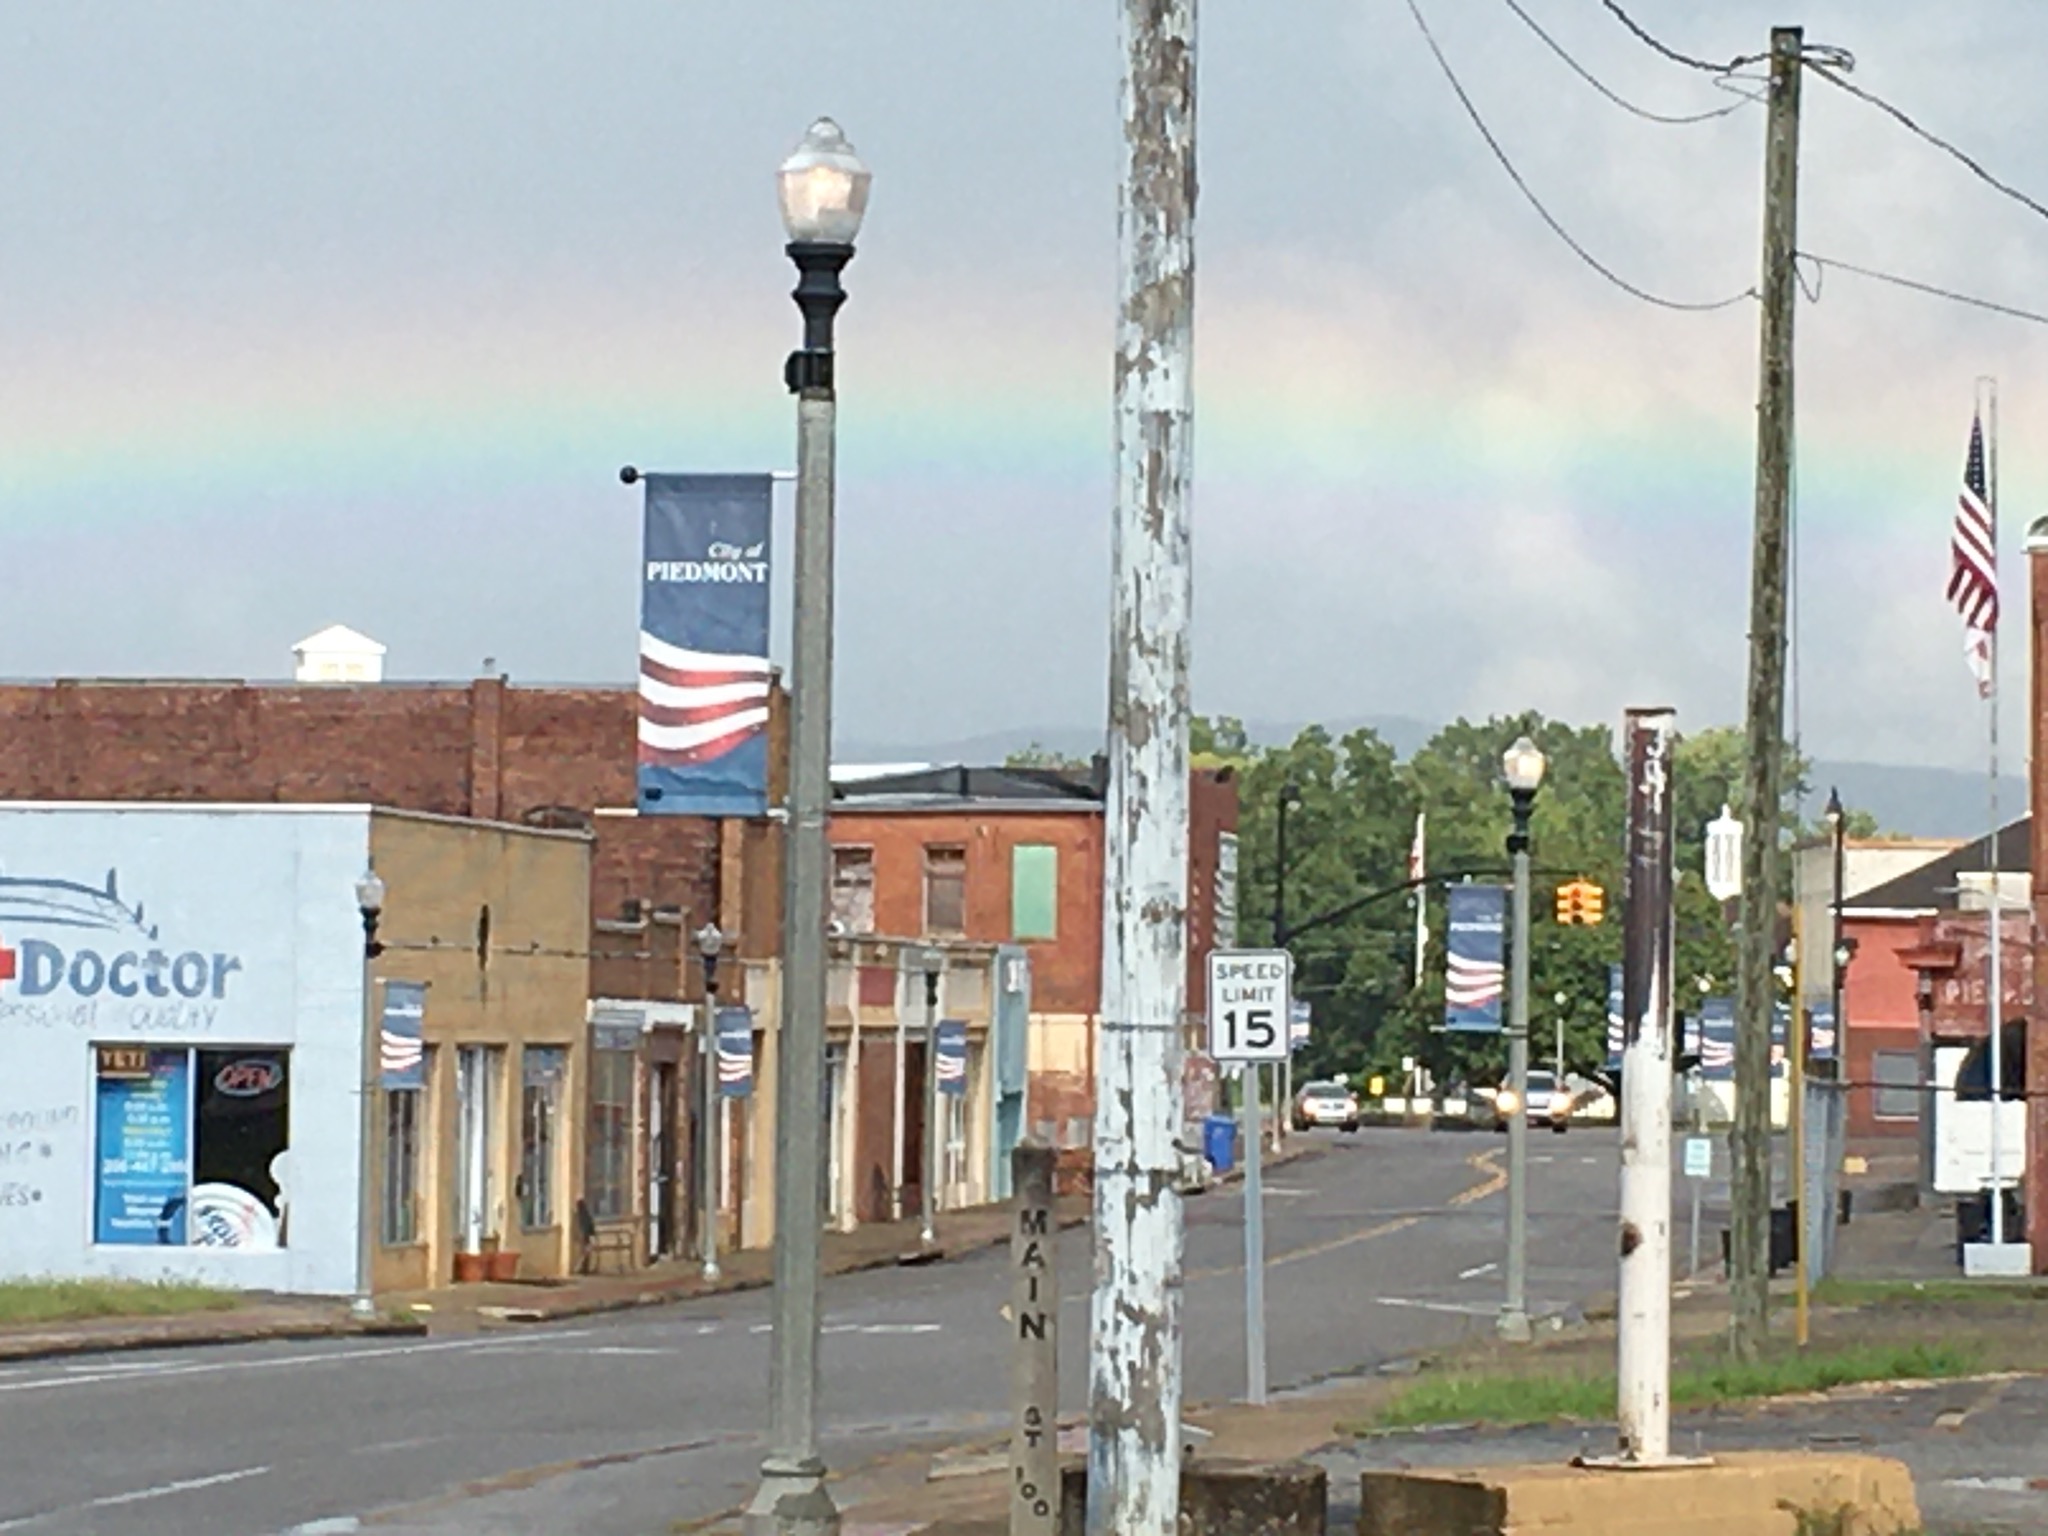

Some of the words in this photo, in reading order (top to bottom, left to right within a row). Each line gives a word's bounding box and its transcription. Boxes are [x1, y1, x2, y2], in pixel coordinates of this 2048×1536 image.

[708, 541, 742, 560] City
[745, 541, 765, 558] of
[647, 561, 768, 582] PIEDMONT
[20, 938, 243, 999] Doctor
[1216, 963, 1284, 980] SPEED
[1222, 986, 1275, 1003] LIMIT
[1224, 1009, 1275, 1049] 15
[221, 1064, 274, 1090] OPEN
[1019, 1209, 1048, 1341] MAIN
[1024, 1405, 1043, 1448] ST
[1015, 1465, 1050, 1517] 100
